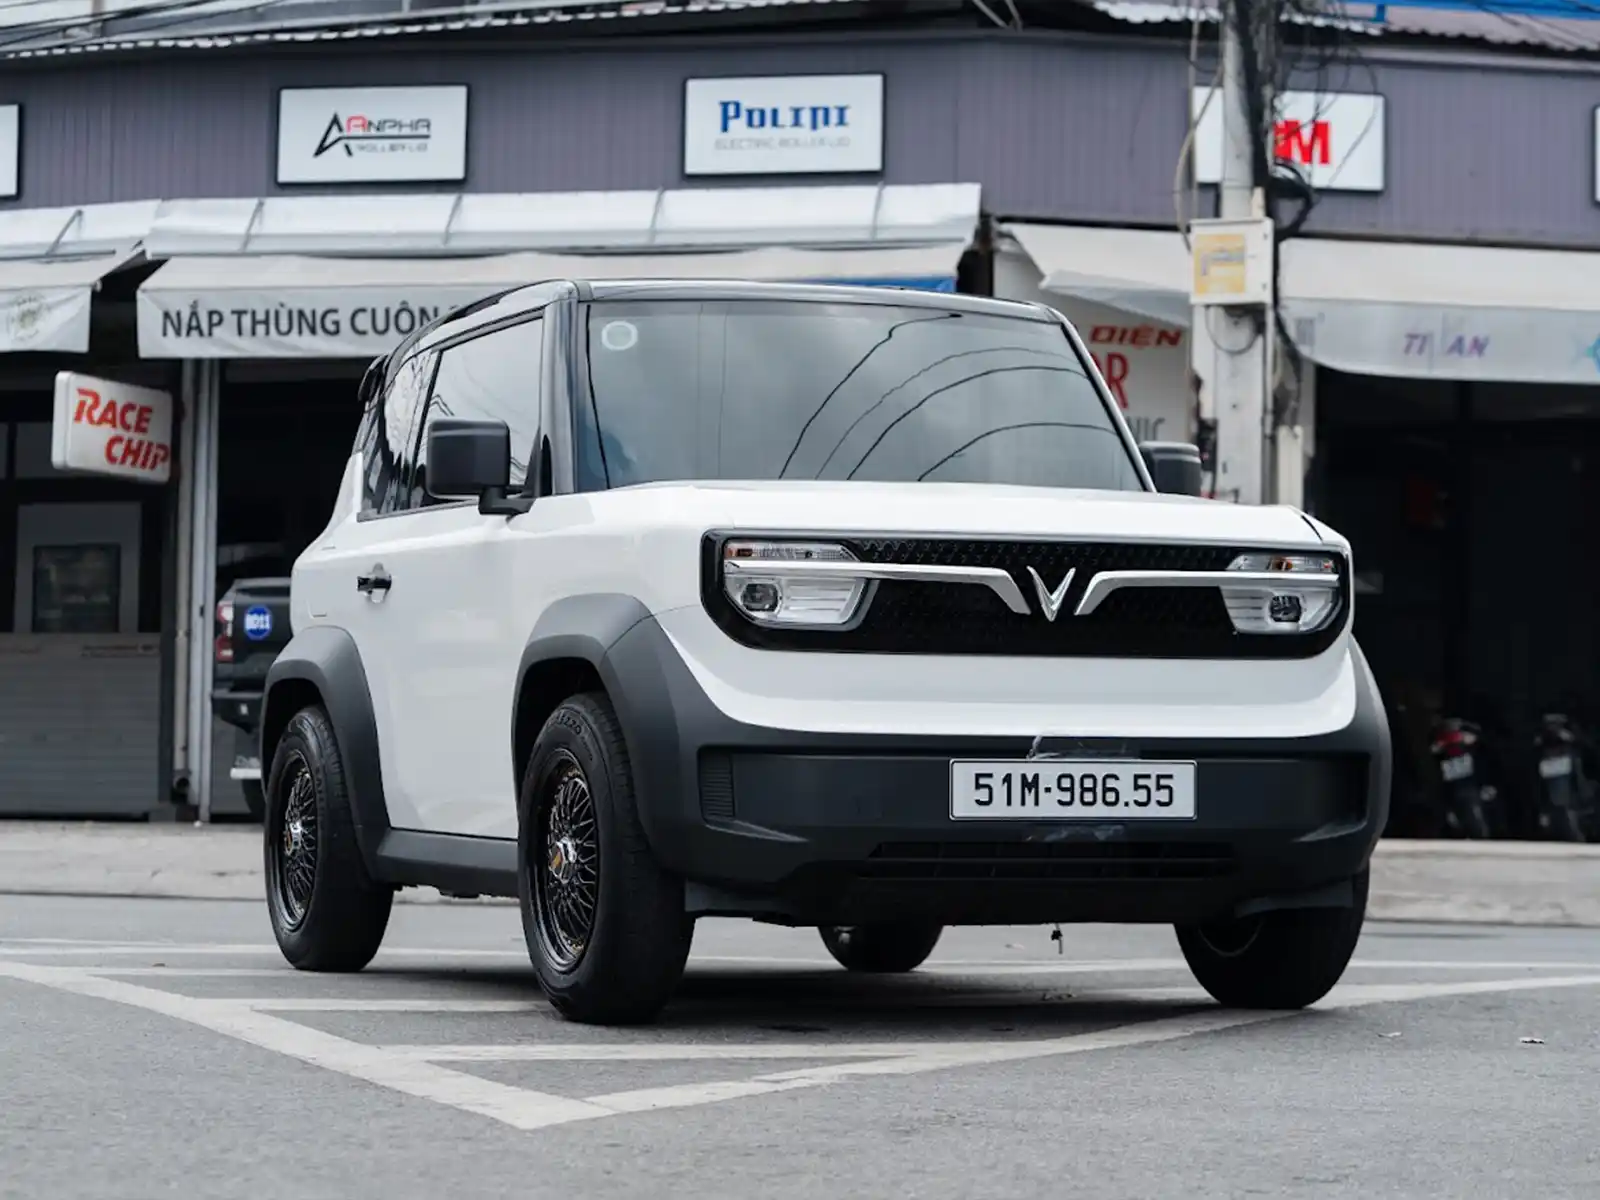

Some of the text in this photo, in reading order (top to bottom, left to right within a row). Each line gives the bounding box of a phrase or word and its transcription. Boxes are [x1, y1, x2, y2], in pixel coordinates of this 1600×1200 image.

[346, 115, 431, 133] ANPHA
[231, 302, 341, 337] THÙNG
[74, 388, 153, 434] RACE
[105, 435, 169, 471] CHIP
[974, 773, 1174, 807] 51M-986.55
